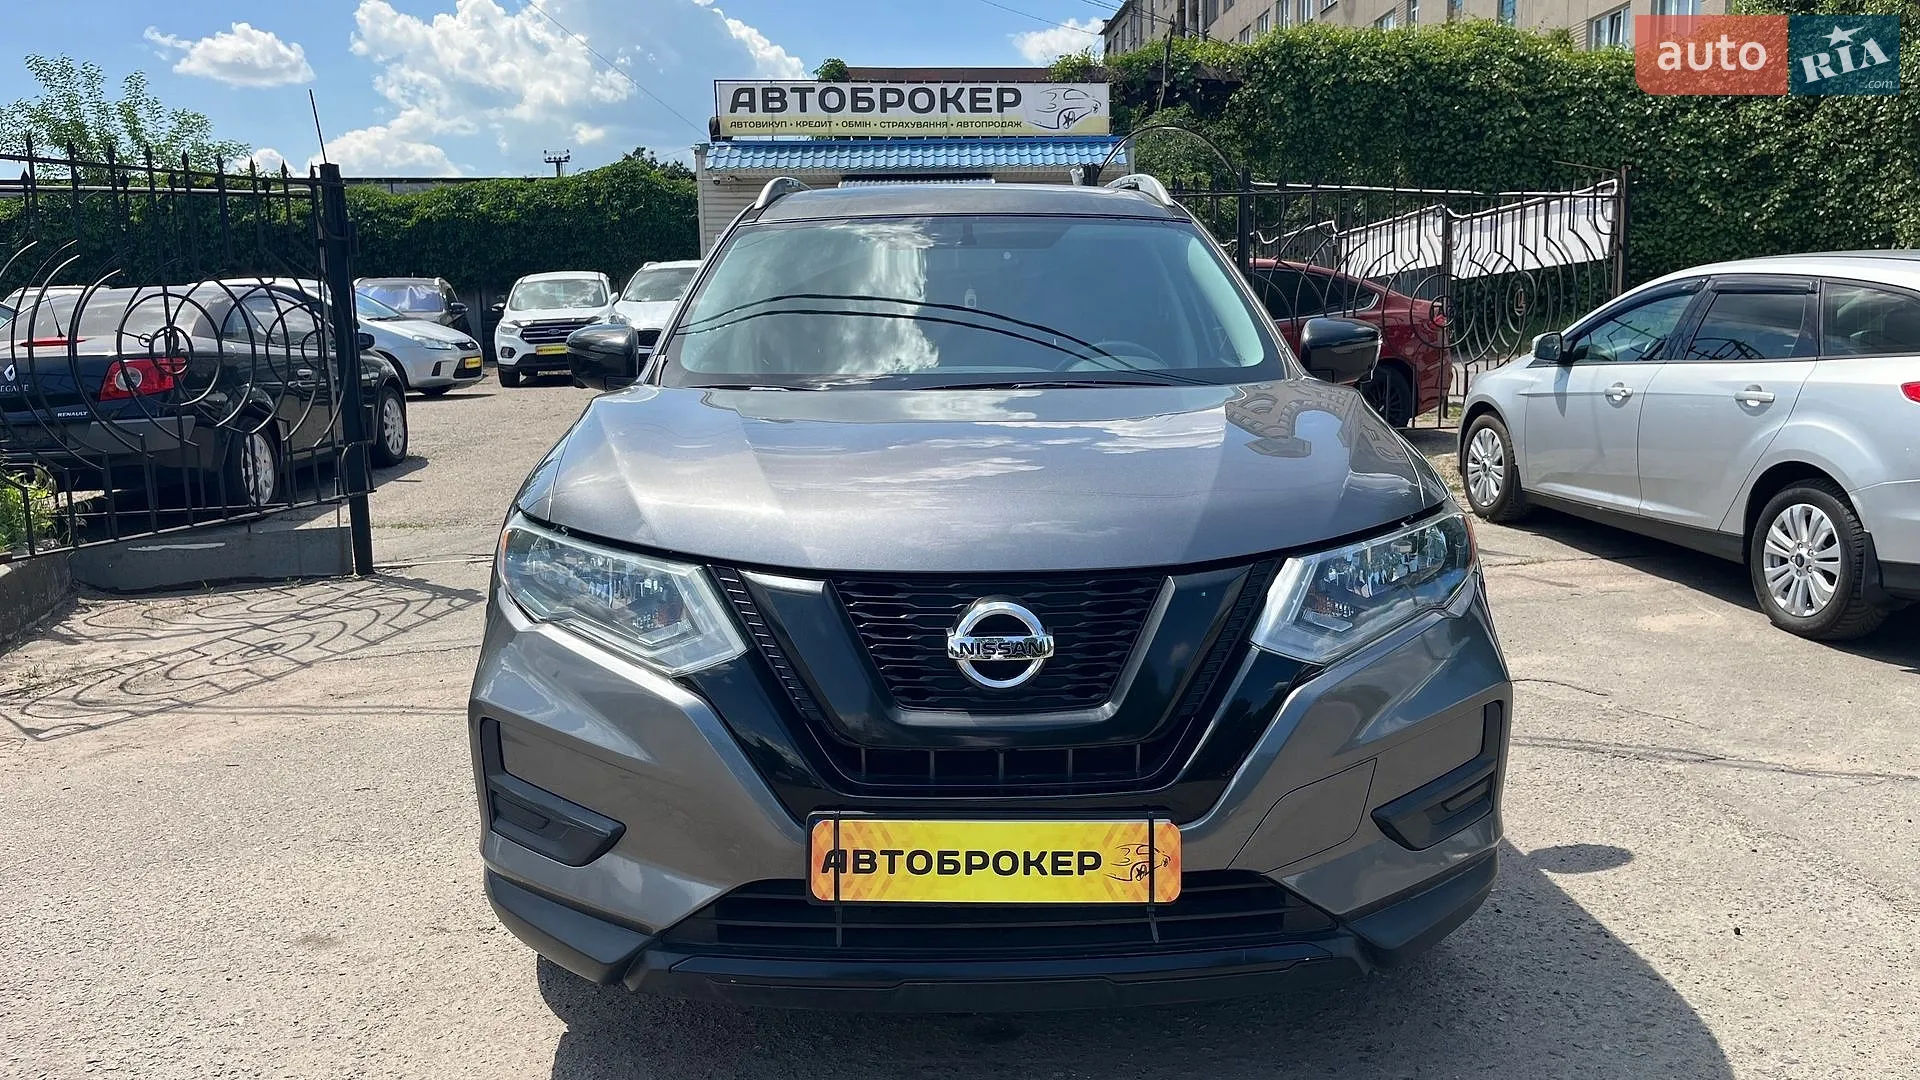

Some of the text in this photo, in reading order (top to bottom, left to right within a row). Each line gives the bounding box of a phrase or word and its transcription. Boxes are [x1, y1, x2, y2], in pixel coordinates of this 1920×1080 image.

[729, 86, 1022, 114] АВТОБРОКЕР
[730, 120, 1023, 129] АВТОВИКУП КРЕДИТ ОБМІН СТРАХУВАННЯ АВТОПРОДАЖ
[57, 410, 89, 418] RENAULT
[959, 642, 1042, 656] NISSAN
[821, 848, 1104, 876] АВТОБРОКЕР
